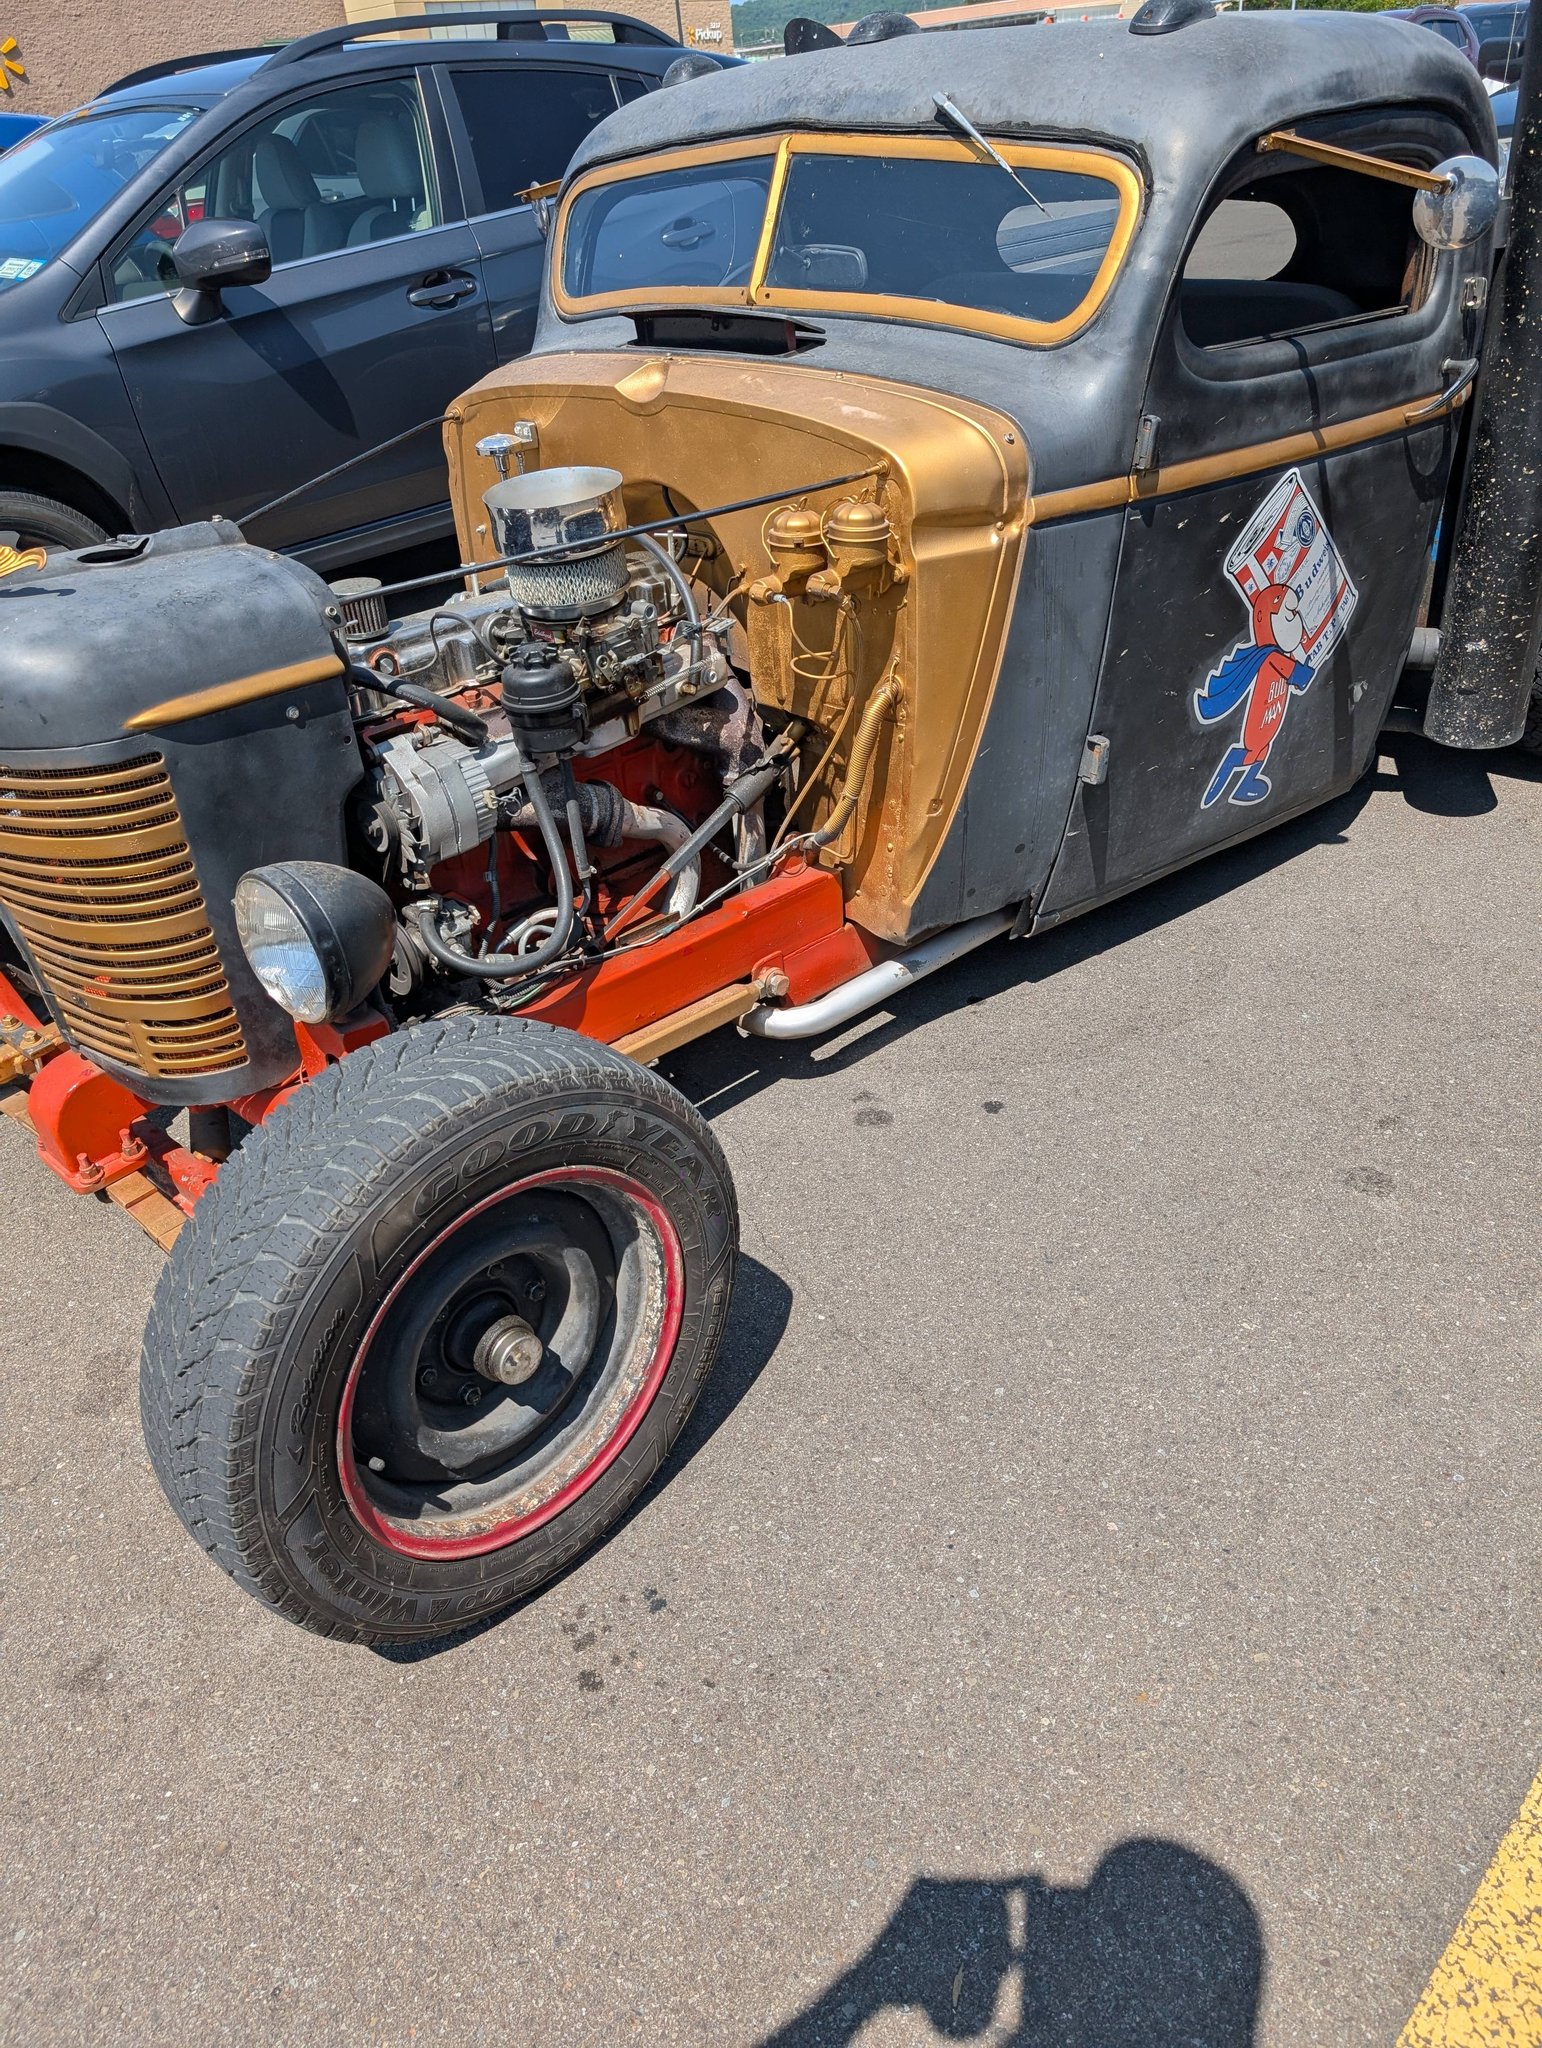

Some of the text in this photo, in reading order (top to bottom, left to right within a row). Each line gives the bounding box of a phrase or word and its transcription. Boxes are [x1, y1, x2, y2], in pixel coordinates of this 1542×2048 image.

[695, 28, 722, 42] Pickup
[1259, 700, 1282, 729] MAN
[1267, 677, 1286, 704] BUD
[413, 1111, 722, 1219] GOODYEAR
[290, 1307, 346, 1435] Rotation
[302, 1540, 418, 1623] Winter
